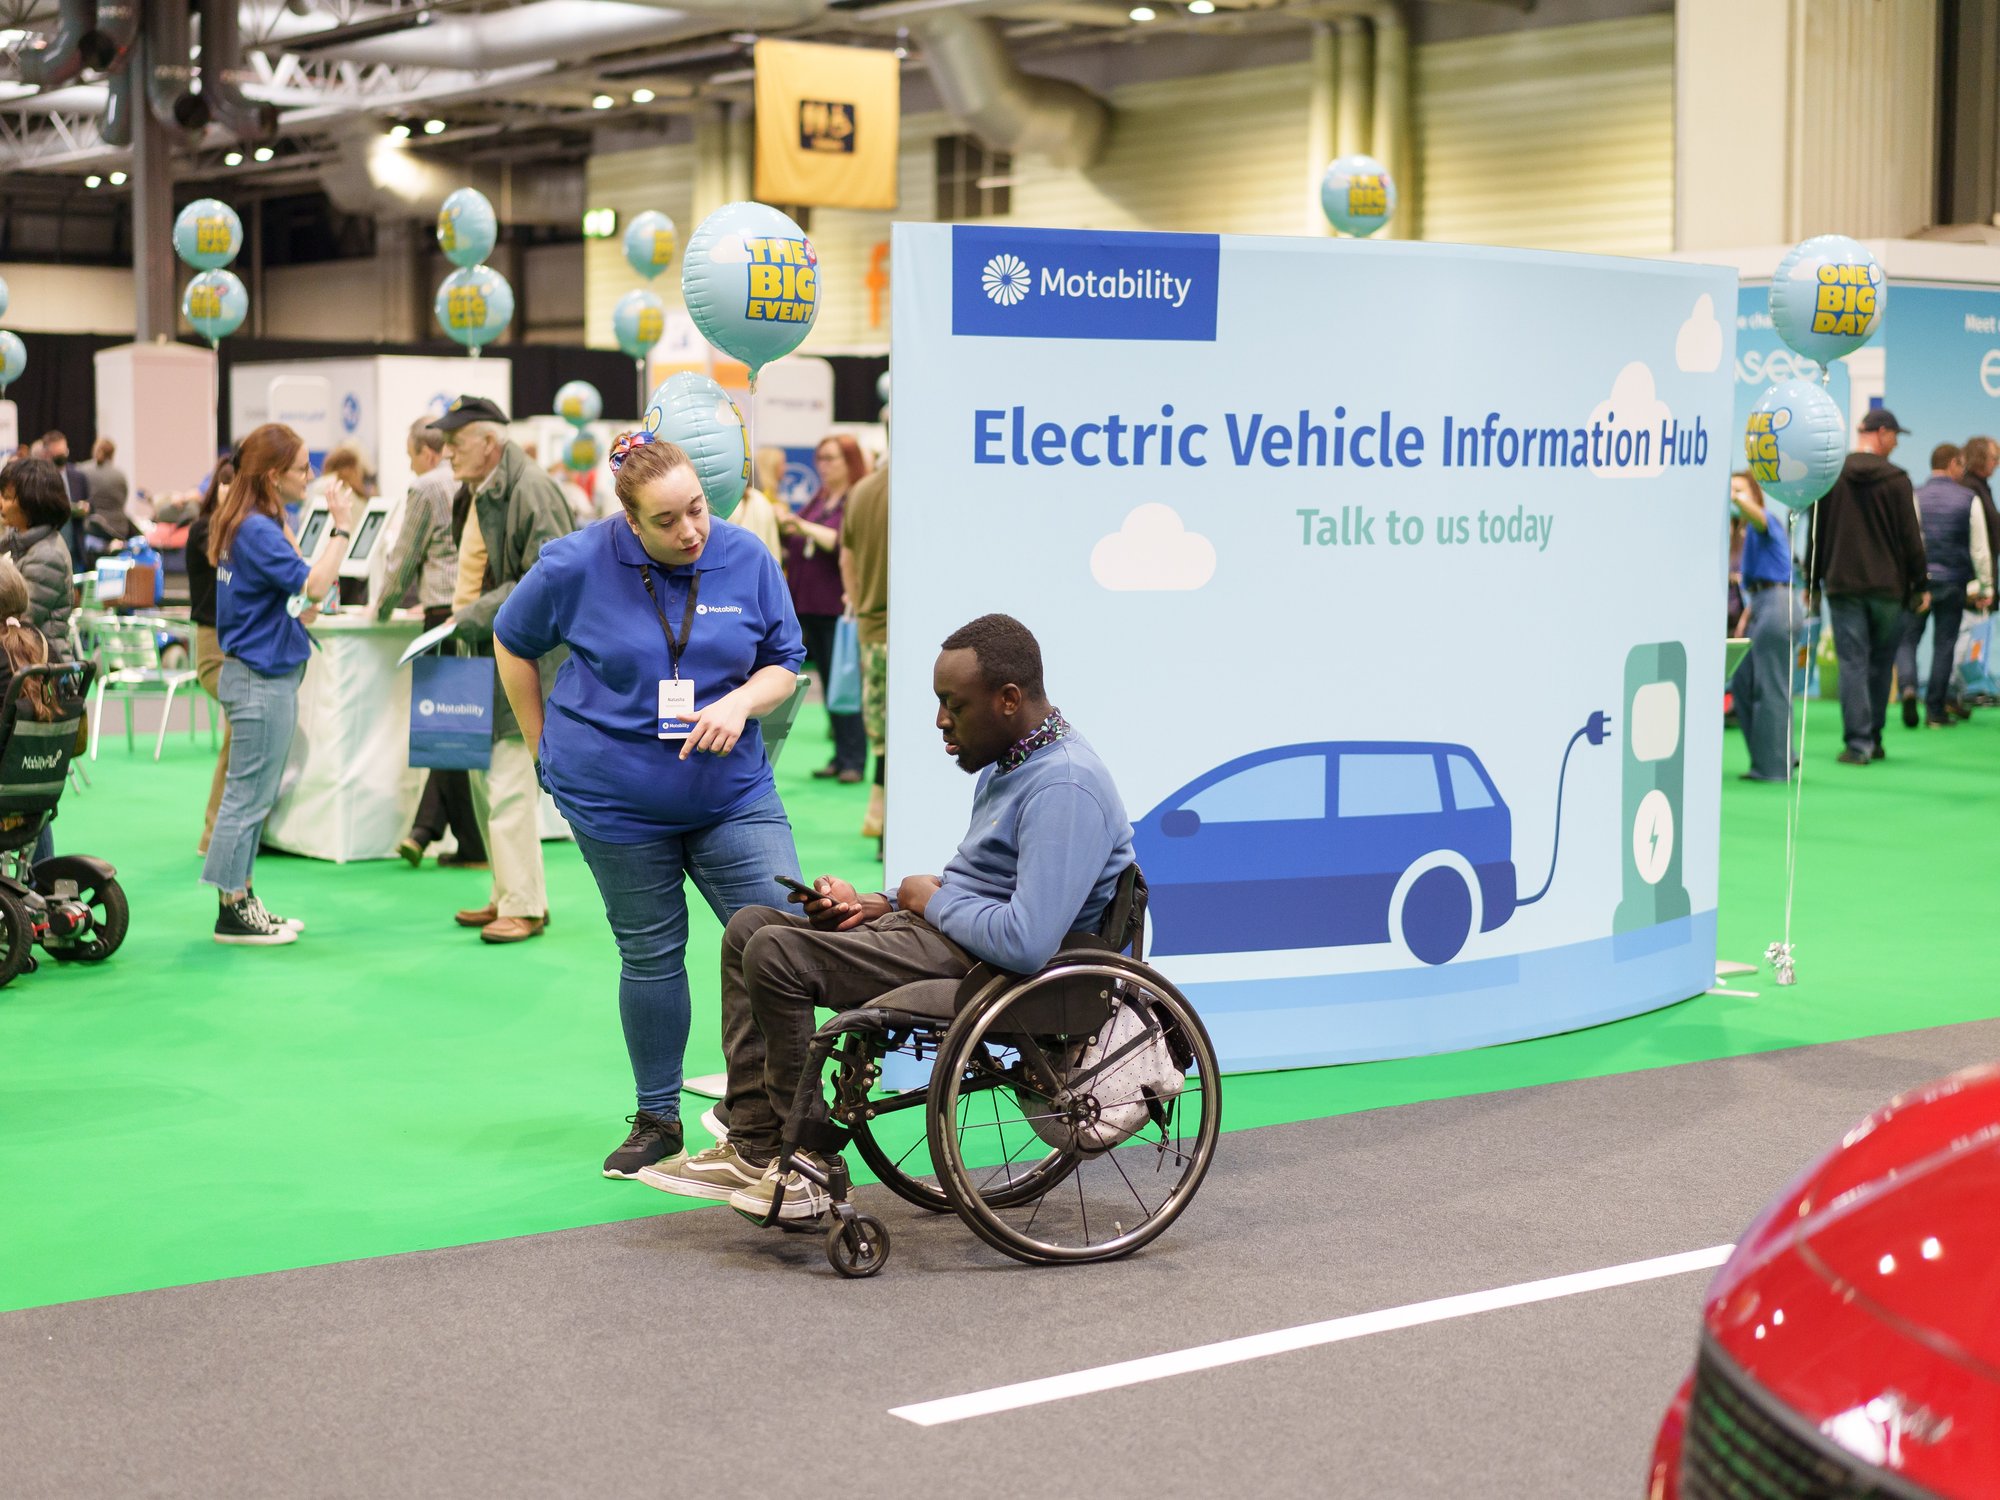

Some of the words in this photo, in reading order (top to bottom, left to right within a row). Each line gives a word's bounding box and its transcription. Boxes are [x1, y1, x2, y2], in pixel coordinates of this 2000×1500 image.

[744, 238, 808, 265] THE
[749, 264, 817, 302] BIG
[1039, 266, 1193, 309] Motability
[1817, 263, 1871, 286] ONE
[747, 299, 815, 323] EVENT
[1816, 284, 1877, 314] BIG
[1812, 311, 1873, 336] DAY
[973, 403, 1209, 467] Electric
[1224, 405, 1425, 468] Vehicle
[1442, 411, 1651, 468] Information
[1658, 414, 1708, 466] Hub
[1296, 504, 1376, 546] Talk
[1385, 509, 1425, 546] to
[1436, 514, 1470, 546] us
[1477, 503, 1554, 552] today
[708, 605, 743, 615] Motability
[436, 702, 485, 718] Motability
